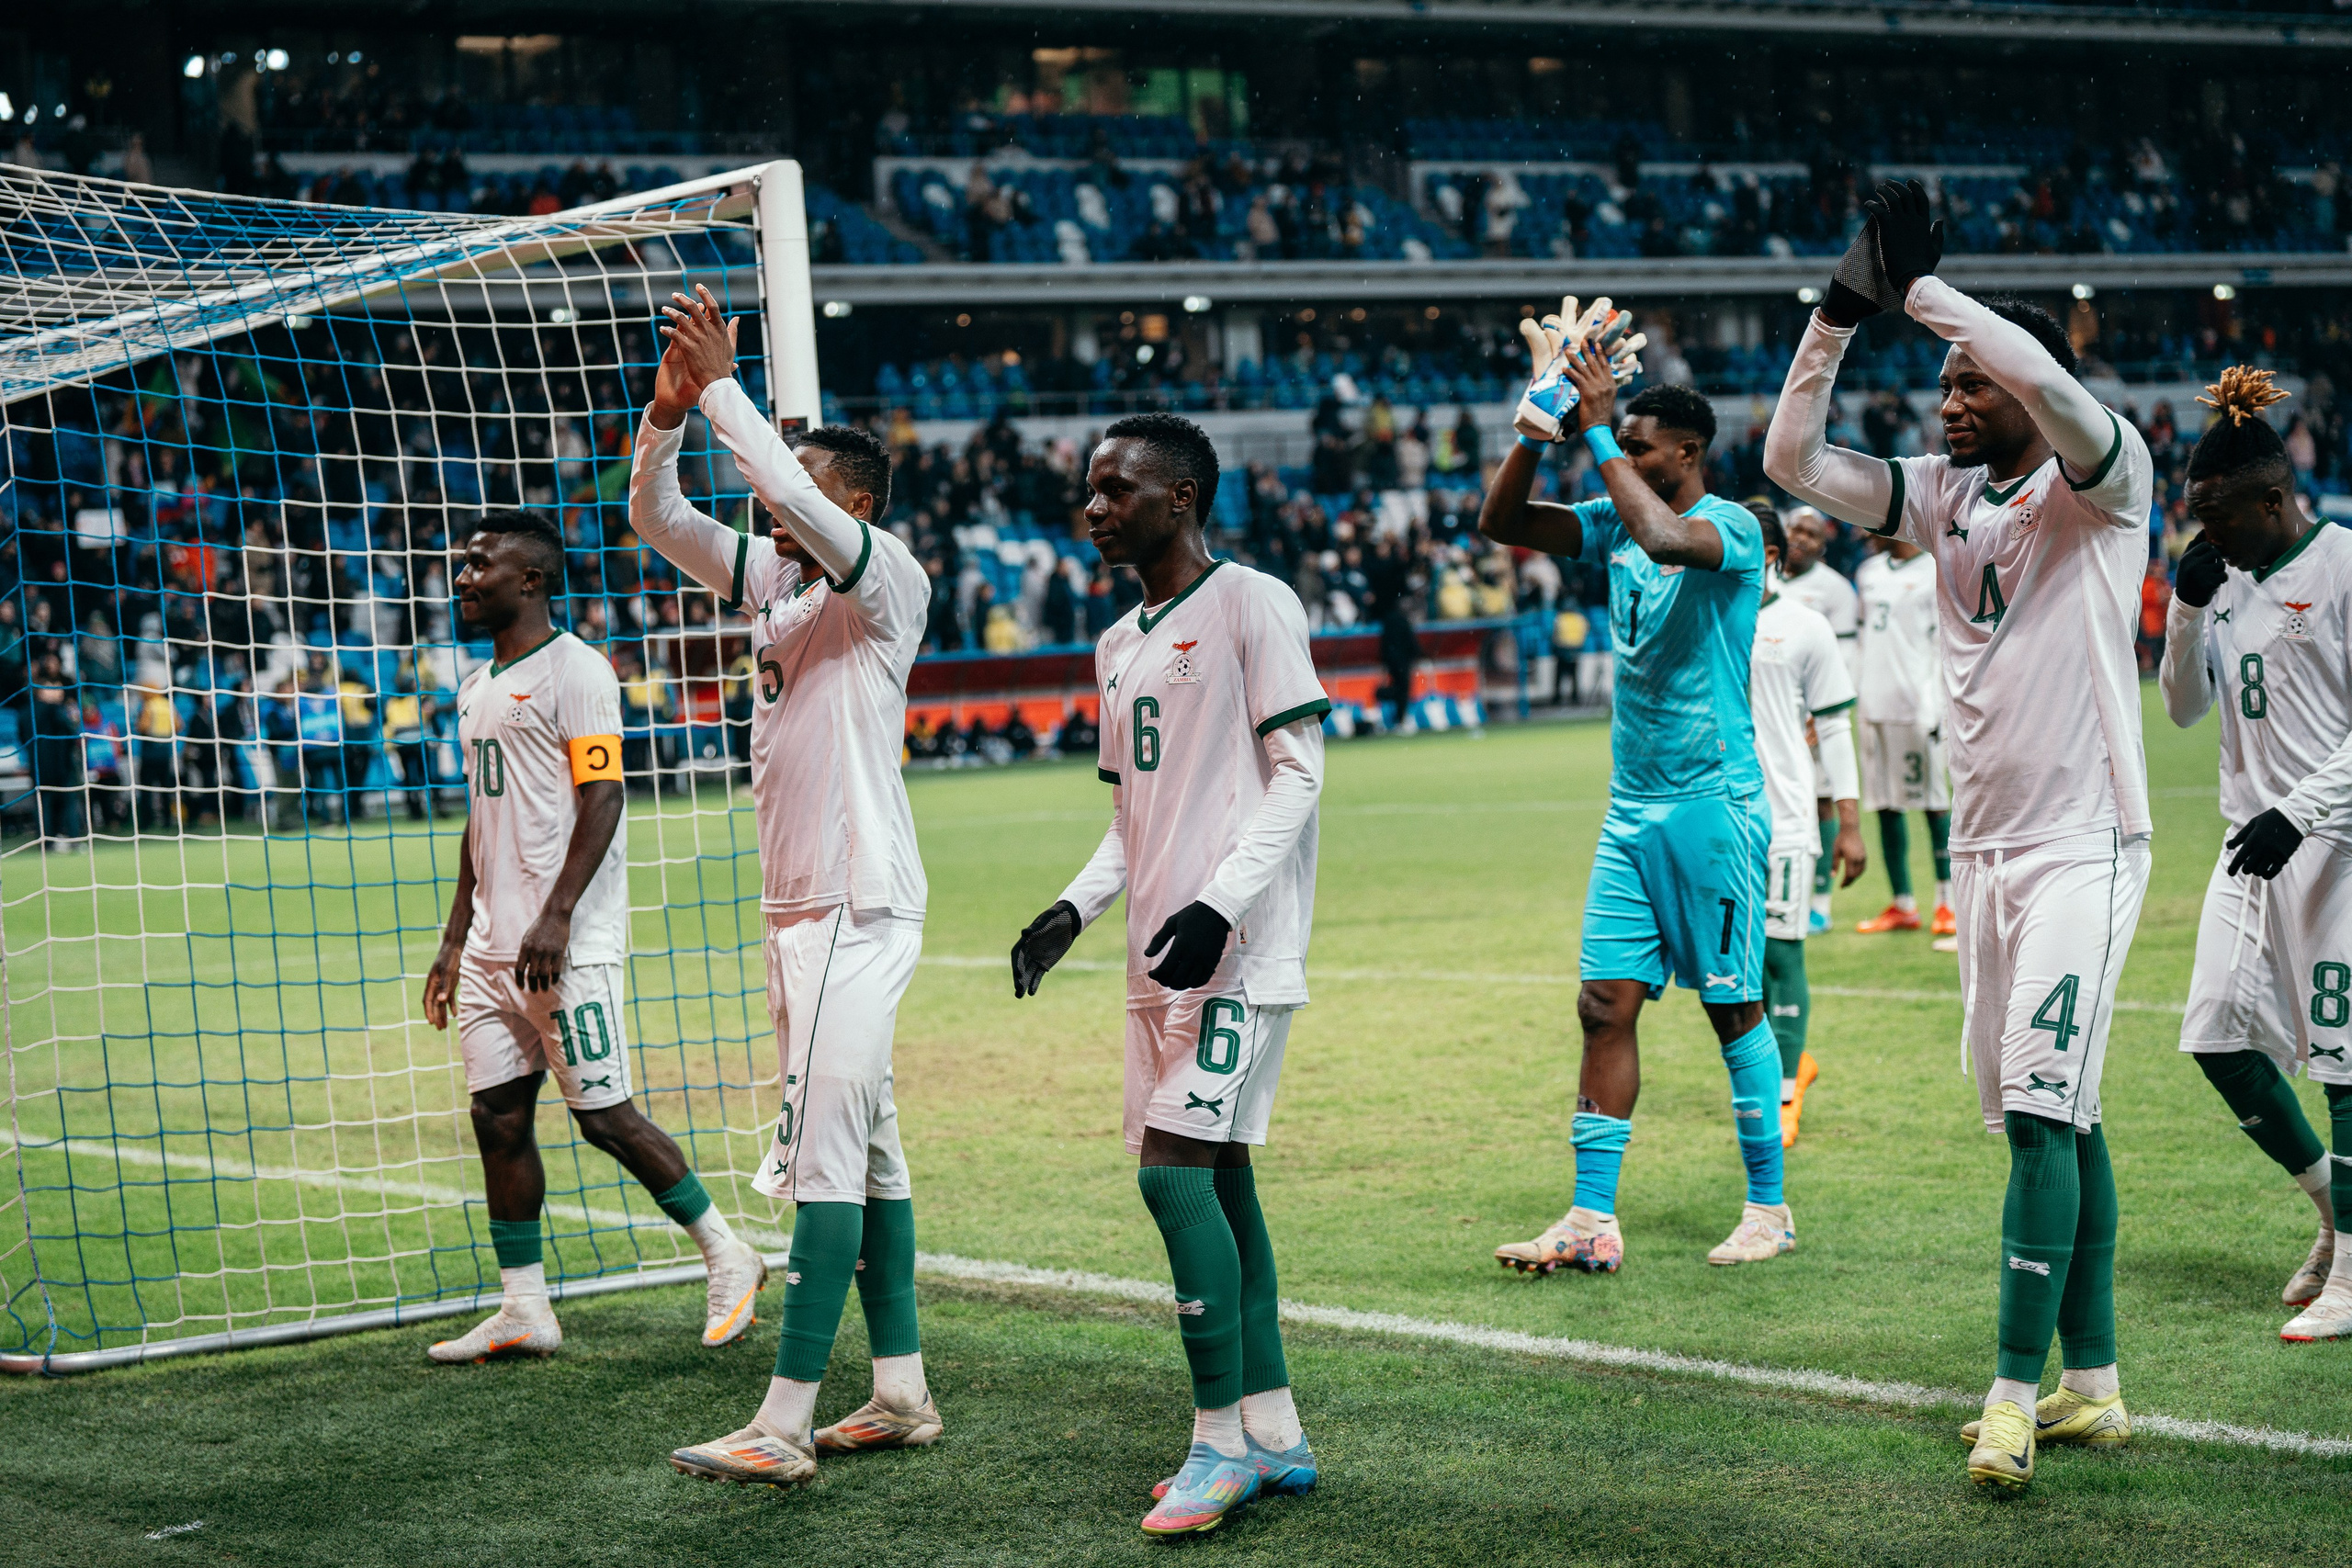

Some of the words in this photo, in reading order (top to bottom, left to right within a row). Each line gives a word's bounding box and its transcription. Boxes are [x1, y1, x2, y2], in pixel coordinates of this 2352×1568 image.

[1629, 590, 1642, 648] 1
[1874, 604, 1890, 631] 3
[1970, 561, 2009, 634] 4
[757, 643, 785, 704] 5
[2240, 653, 2267, 719] 8
[1133, 696, 1160, 772] 6
[470, 739, 504, 797] 10
[1904, 750, 1923, 785] 3
[1718, 897, 1736, 955] 1
[2030, 974, 2080, 1052] 4
[2311, 961, 2351, 1028] 8
[549, 1001, 611, 1066] 10
[1196, 997, 1245, 1075] 6
[778, 1074, 797, 1146] 5
